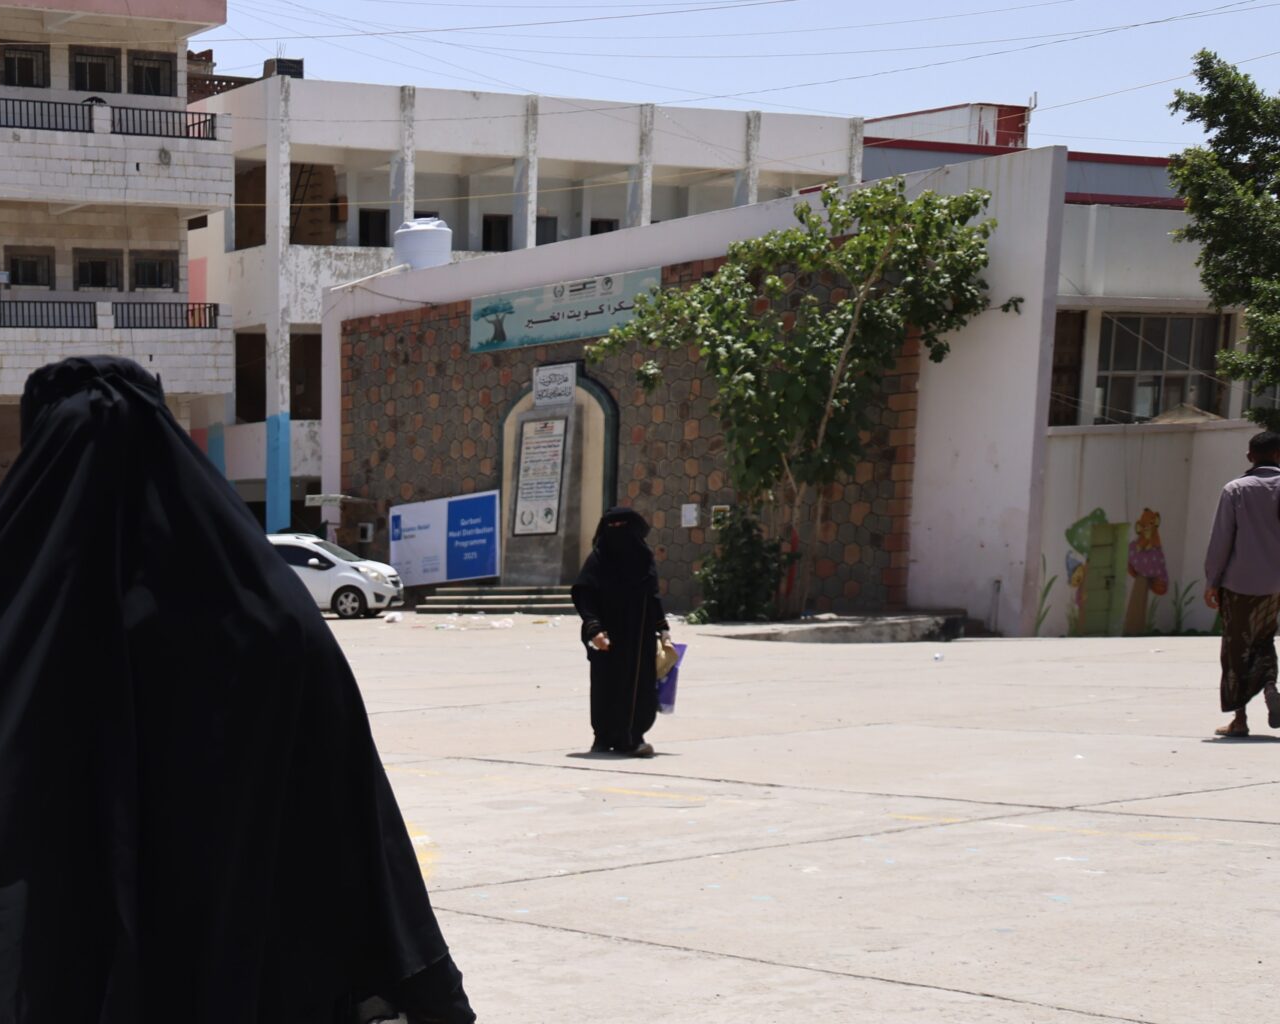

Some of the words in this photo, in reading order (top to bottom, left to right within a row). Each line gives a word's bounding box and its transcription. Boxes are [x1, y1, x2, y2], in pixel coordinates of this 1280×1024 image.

[567, 304, 605, 321] كويت
[608, 301, 635, 315] كرا
[524, 311, 565, 329] الخير
[460, 517, 482, 526] Qurbani
[462, 526, 494, 536] Distribution
[454, 538, 487, 548] Programme
